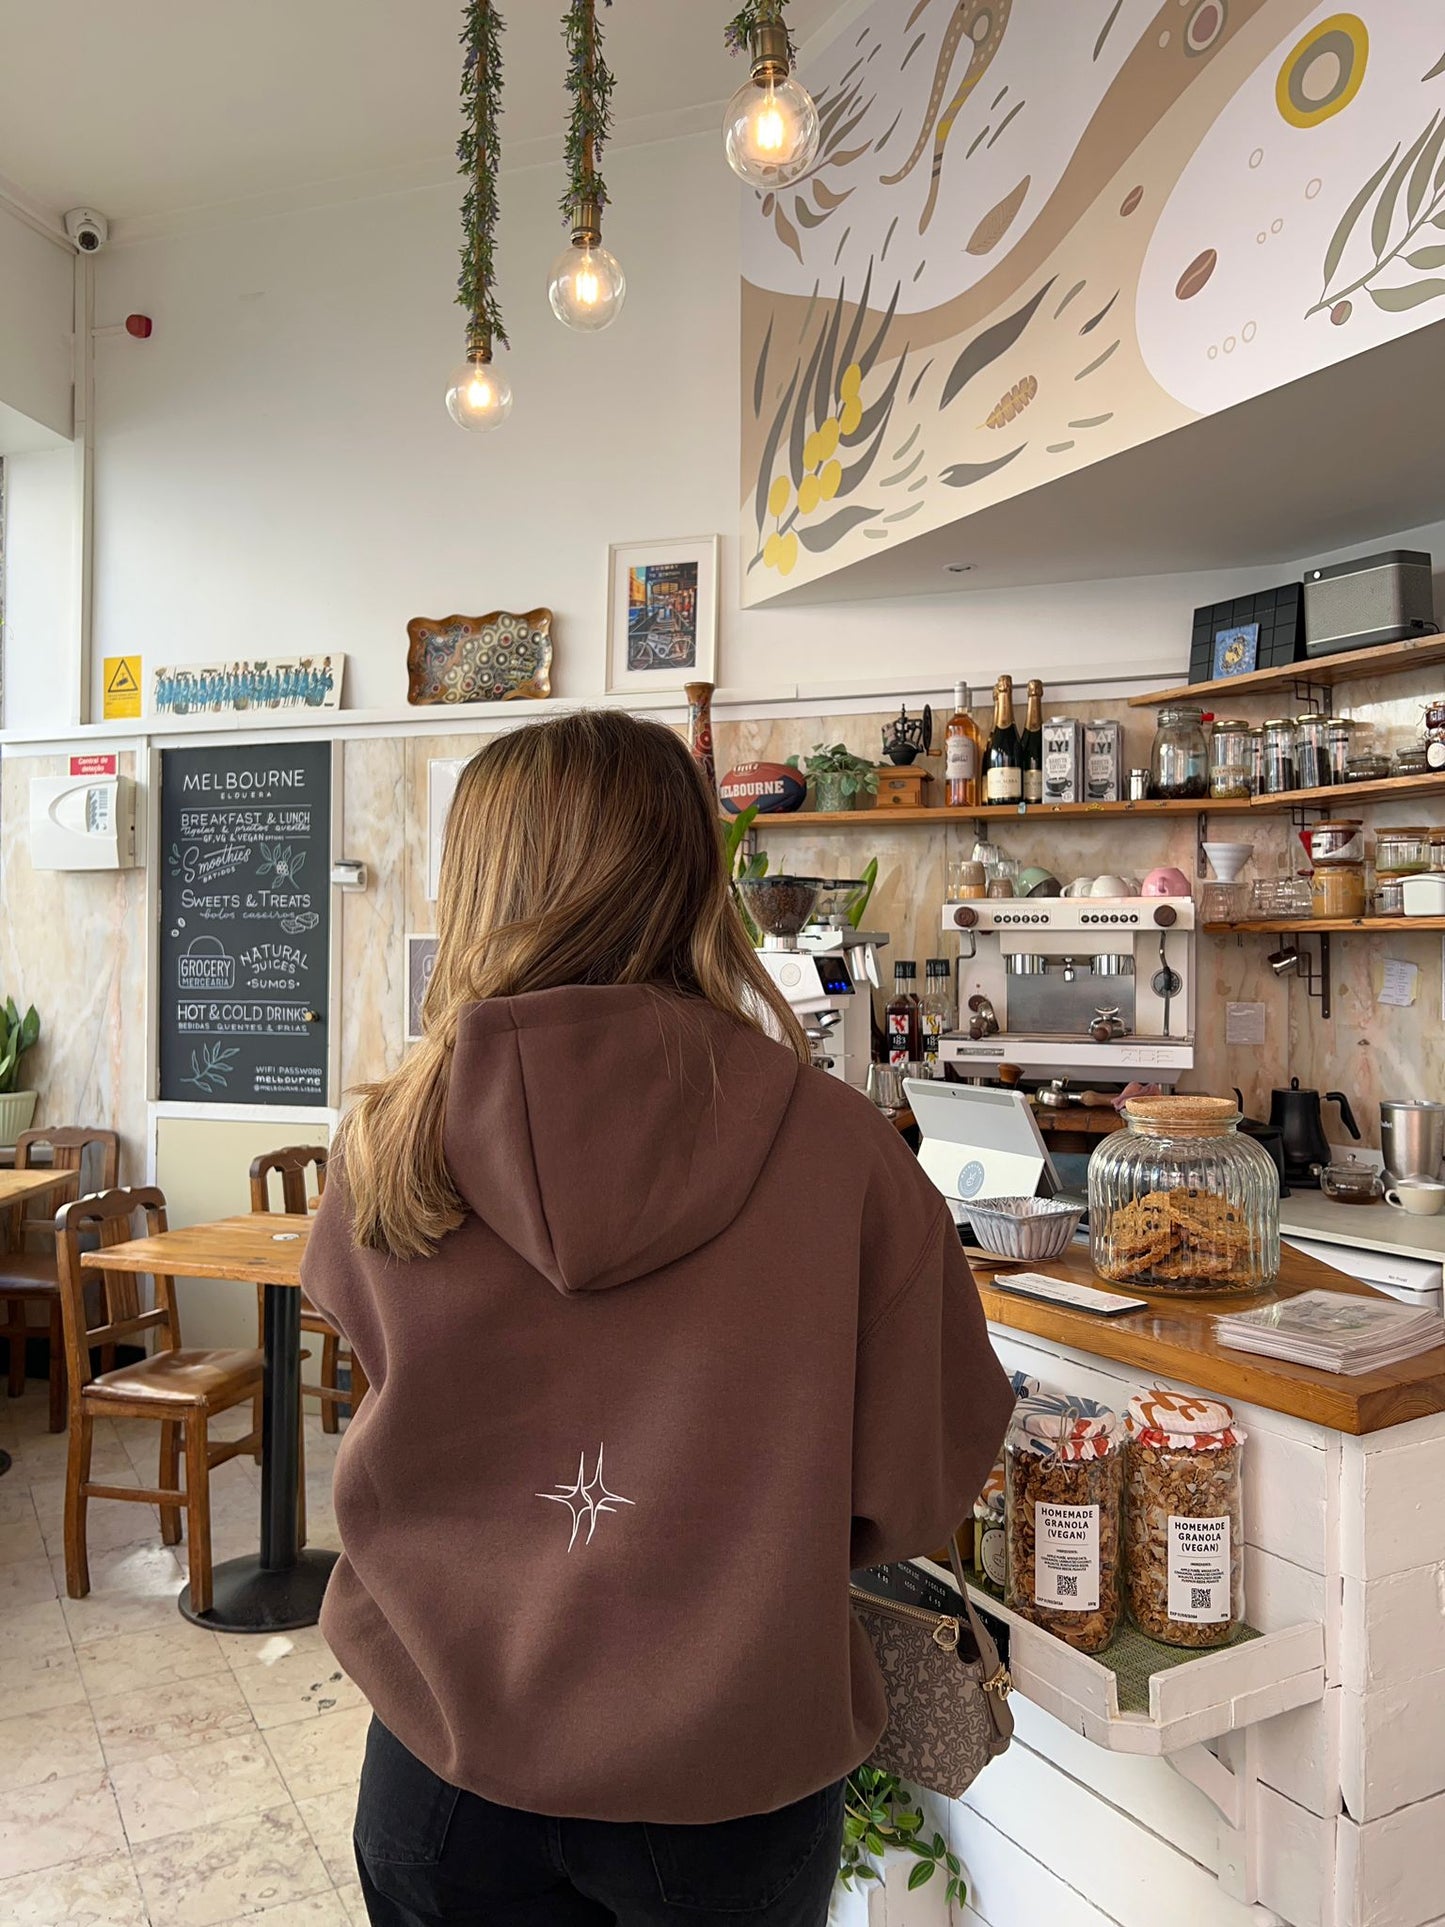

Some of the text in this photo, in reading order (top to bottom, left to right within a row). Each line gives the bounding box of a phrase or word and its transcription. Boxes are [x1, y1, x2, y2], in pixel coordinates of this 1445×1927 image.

[1049, 740, 1068, 752] LY!
[1091, 742, 1111, 754] LY!
[183, 769, 305, 792] MELBOURNE
[181, 811, 310, 826] BREAKFAST & LUNCH
[237, 832, 264, 841] VEGAN
[183, 844, 251, 883] Smoothies
[181, 889, 311, 908] SWEETS & TREATS
[240, 944, 309, 970] NATURAL
[181, 958, 230, 977] GROCERY
[251, 959, 296, 974] JUICES
[182, 977, 229, 986] MERCEARIA
[178, 1004, 308, 1021] HOT & COLD DRINKS
[178, 1022, 210, 1030] BEBIDAS
[217, 1023, 262, 1031] QUENTES
[278, 1024, 307, 1032] FRIAS
[255, 1065, 322, 1075] WIFI PASSWORD
[1041, 1507, 1093, 1518] HOMEMADE
[1045, 1518, 1089, 1529] GRANOLA
[1175, 1522, 1225, 1531] HOMEMADE
[1047, 1529, 1086, 1540] (VEGAN)
[1178, 1532, 1221, 1541] GRANOLA
[1181, 1543, 1219, 1552] (VEGAN)
